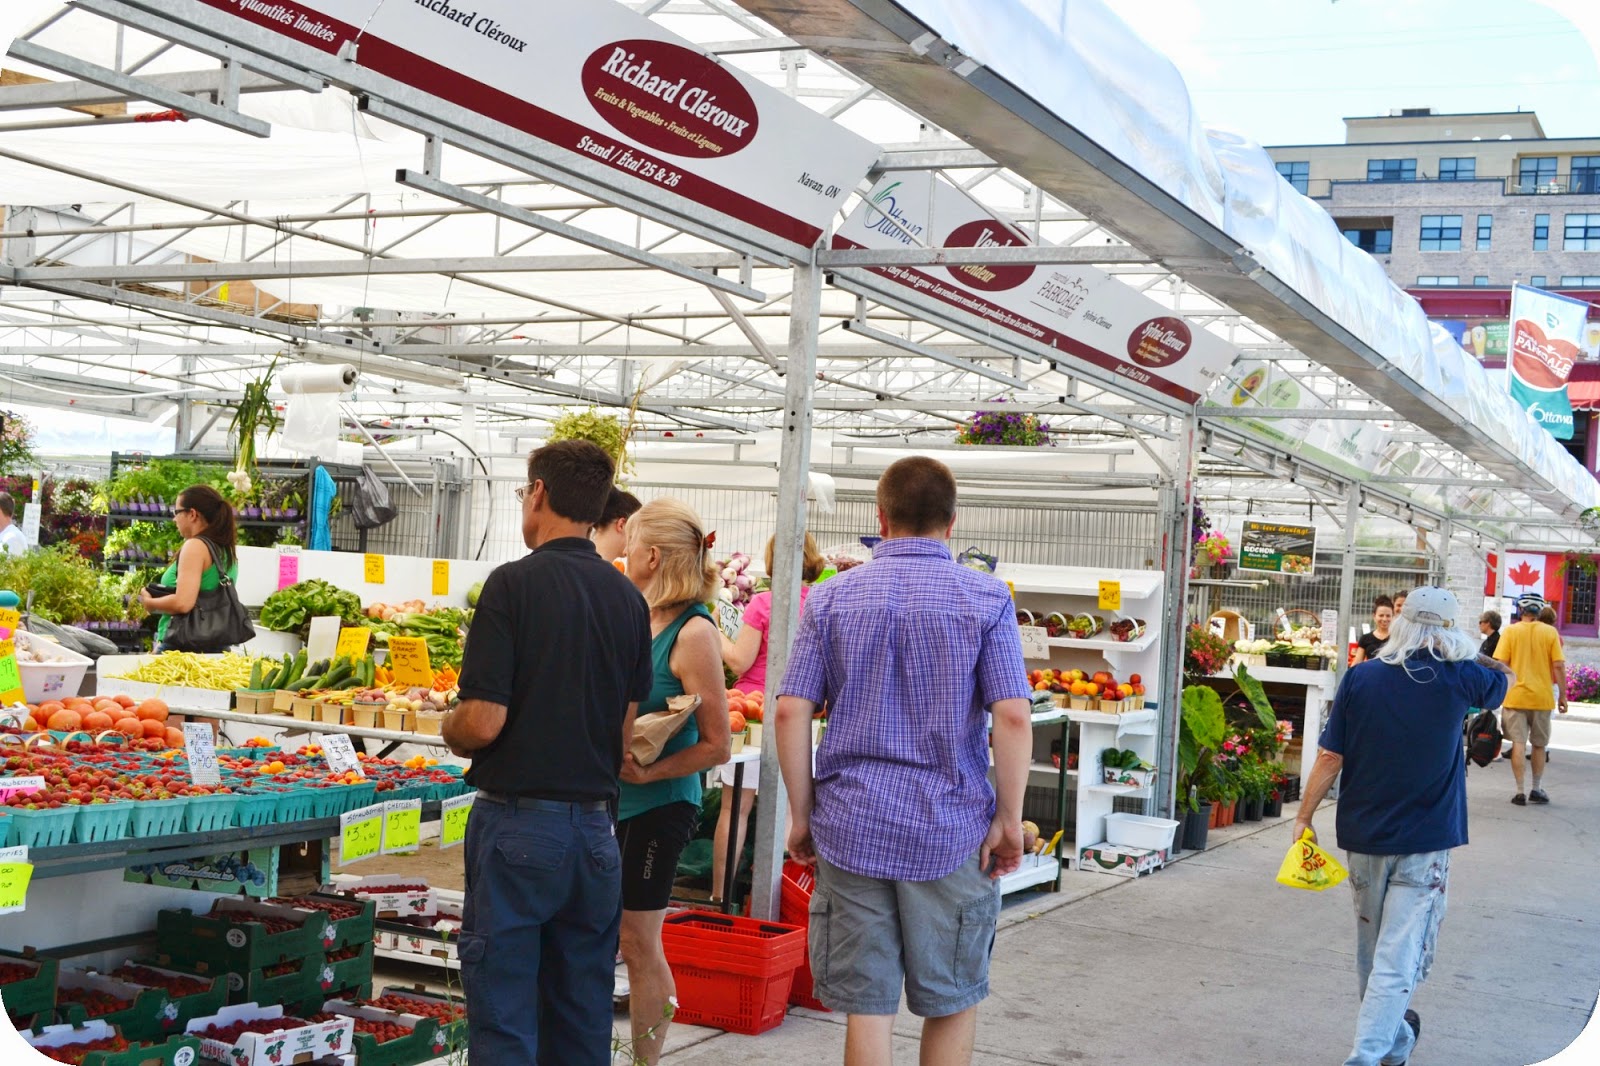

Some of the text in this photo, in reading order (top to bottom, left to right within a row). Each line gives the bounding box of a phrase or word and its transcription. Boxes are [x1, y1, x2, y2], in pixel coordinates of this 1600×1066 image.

[239, 0, 337, 43] quantités limitées
[474, 18, 528, 53] Cléroux
[600, 46, 749, 138] Richard Cléroux
[593, 87, 722, 154] Fruits & Vegetables Fruits et Légumes
[576, 136, 682, 188] Stand / Étal 25 & 26
[797, 172, 841, 199] Navan, ON
[1036, 280, 1084, 311] PARKDALE
[1160, 330, 1187, 352] Cléroux
[1529, 403, 1574, 425] Ottawa
[1243, 545, 1276, 554] ROCHON
[643, 847, 656, 879] CRAFT
